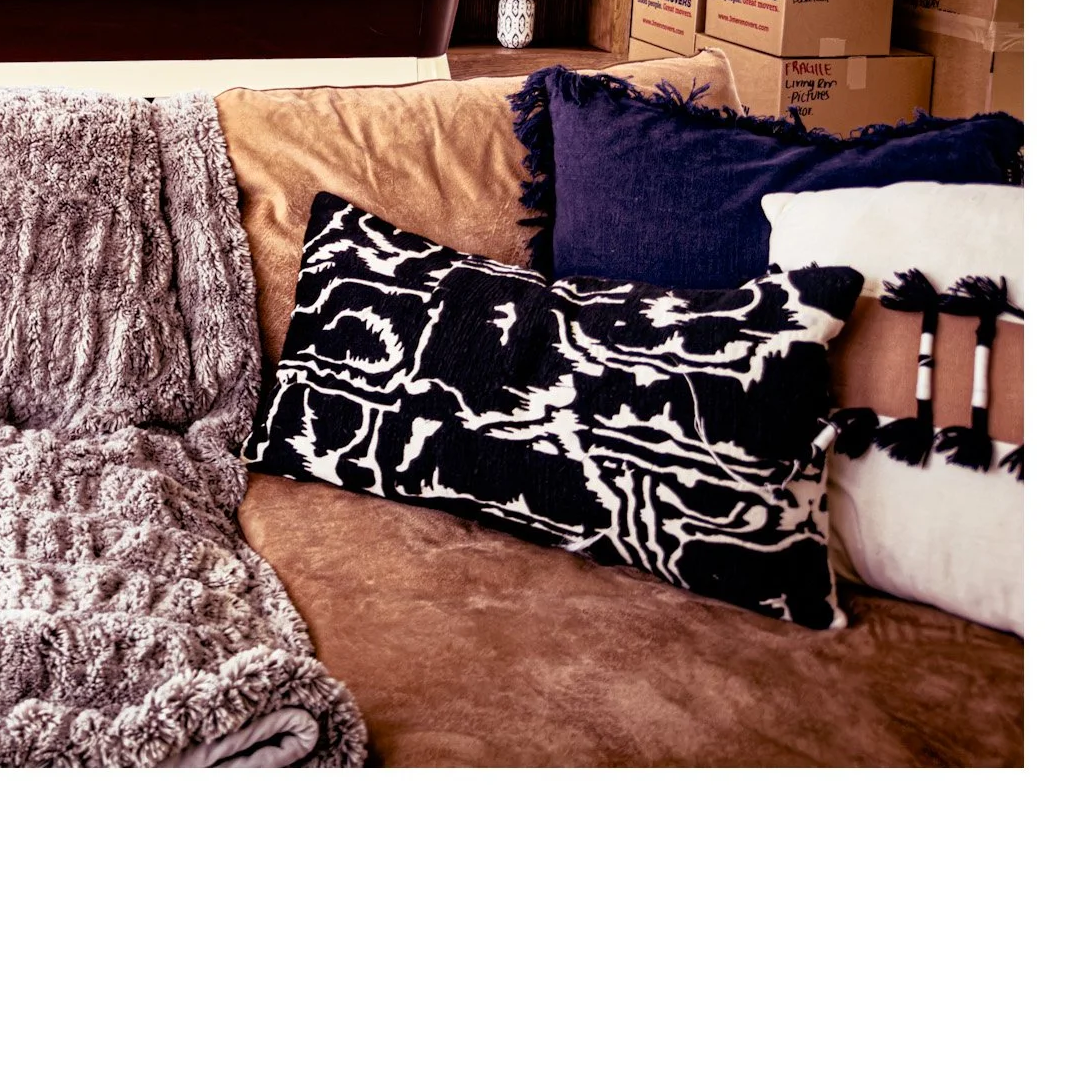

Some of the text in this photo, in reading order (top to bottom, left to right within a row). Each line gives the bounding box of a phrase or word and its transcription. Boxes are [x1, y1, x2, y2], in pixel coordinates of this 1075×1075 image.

[663, 2, 675, 13] Great
[675, 6, 692, 18] movers.
[757, 1, 780, 12] movers.
[718, 13, 769, 32] www.3menmovers.com
[785, 60, 832, 76] FRAGILE
